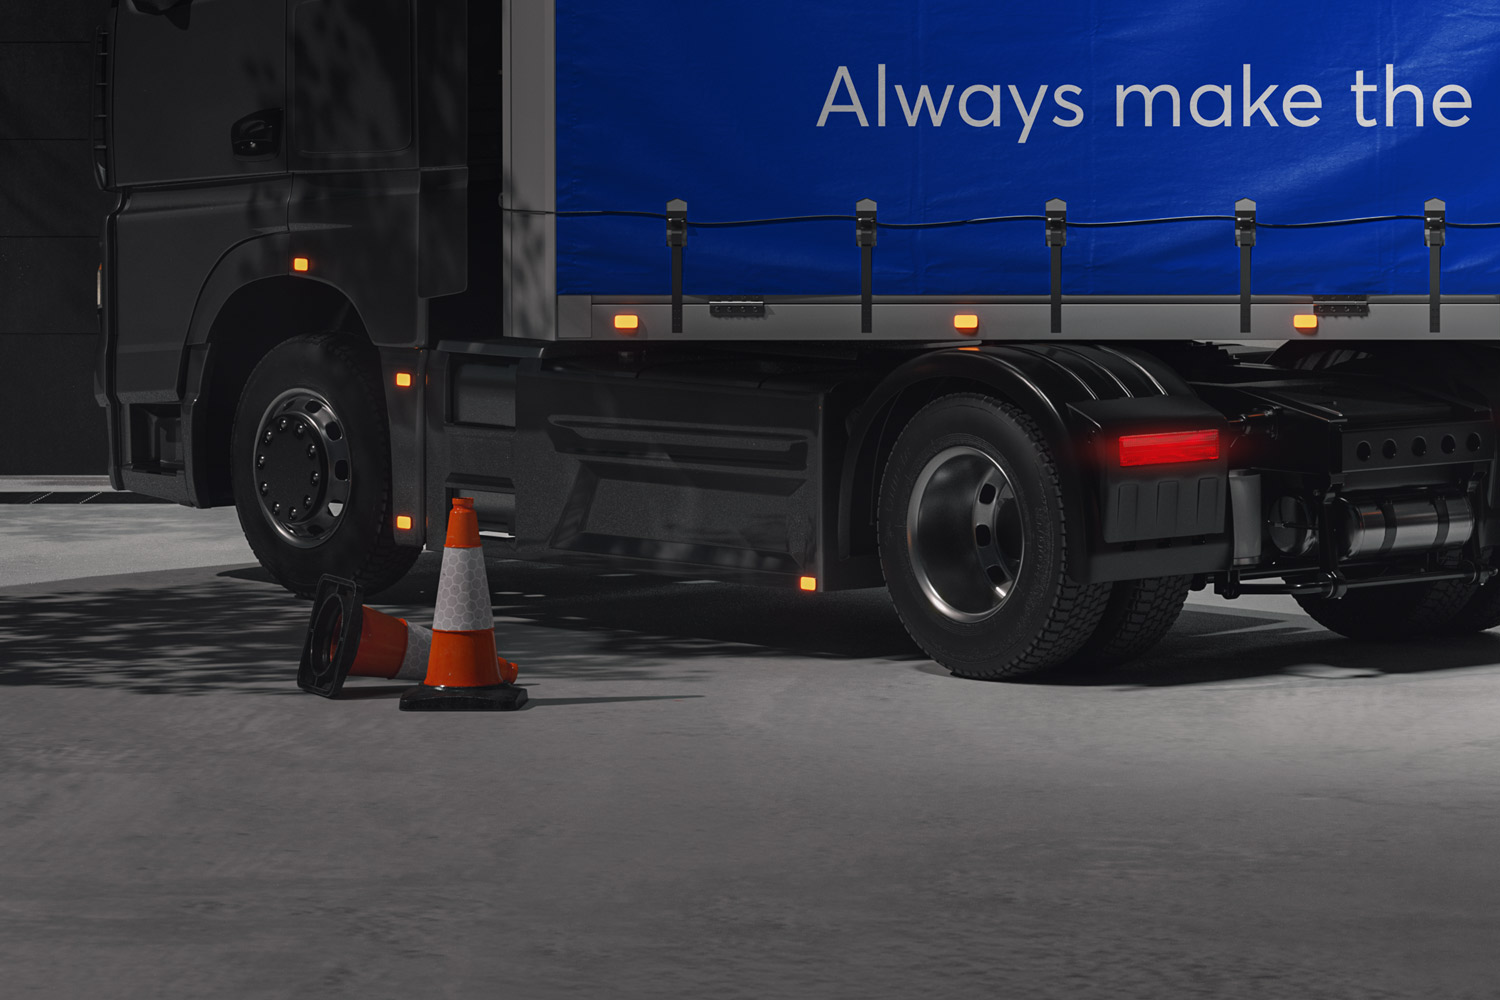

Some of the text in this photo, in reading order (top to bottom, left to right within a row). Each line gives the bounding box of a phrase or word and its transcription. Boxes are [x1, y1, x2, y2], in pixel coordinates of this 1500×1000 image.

[816, 63, 1084, 144] Always
[1115, 63, 1323, 128] make
[1350, 63, 1473, 128] the
